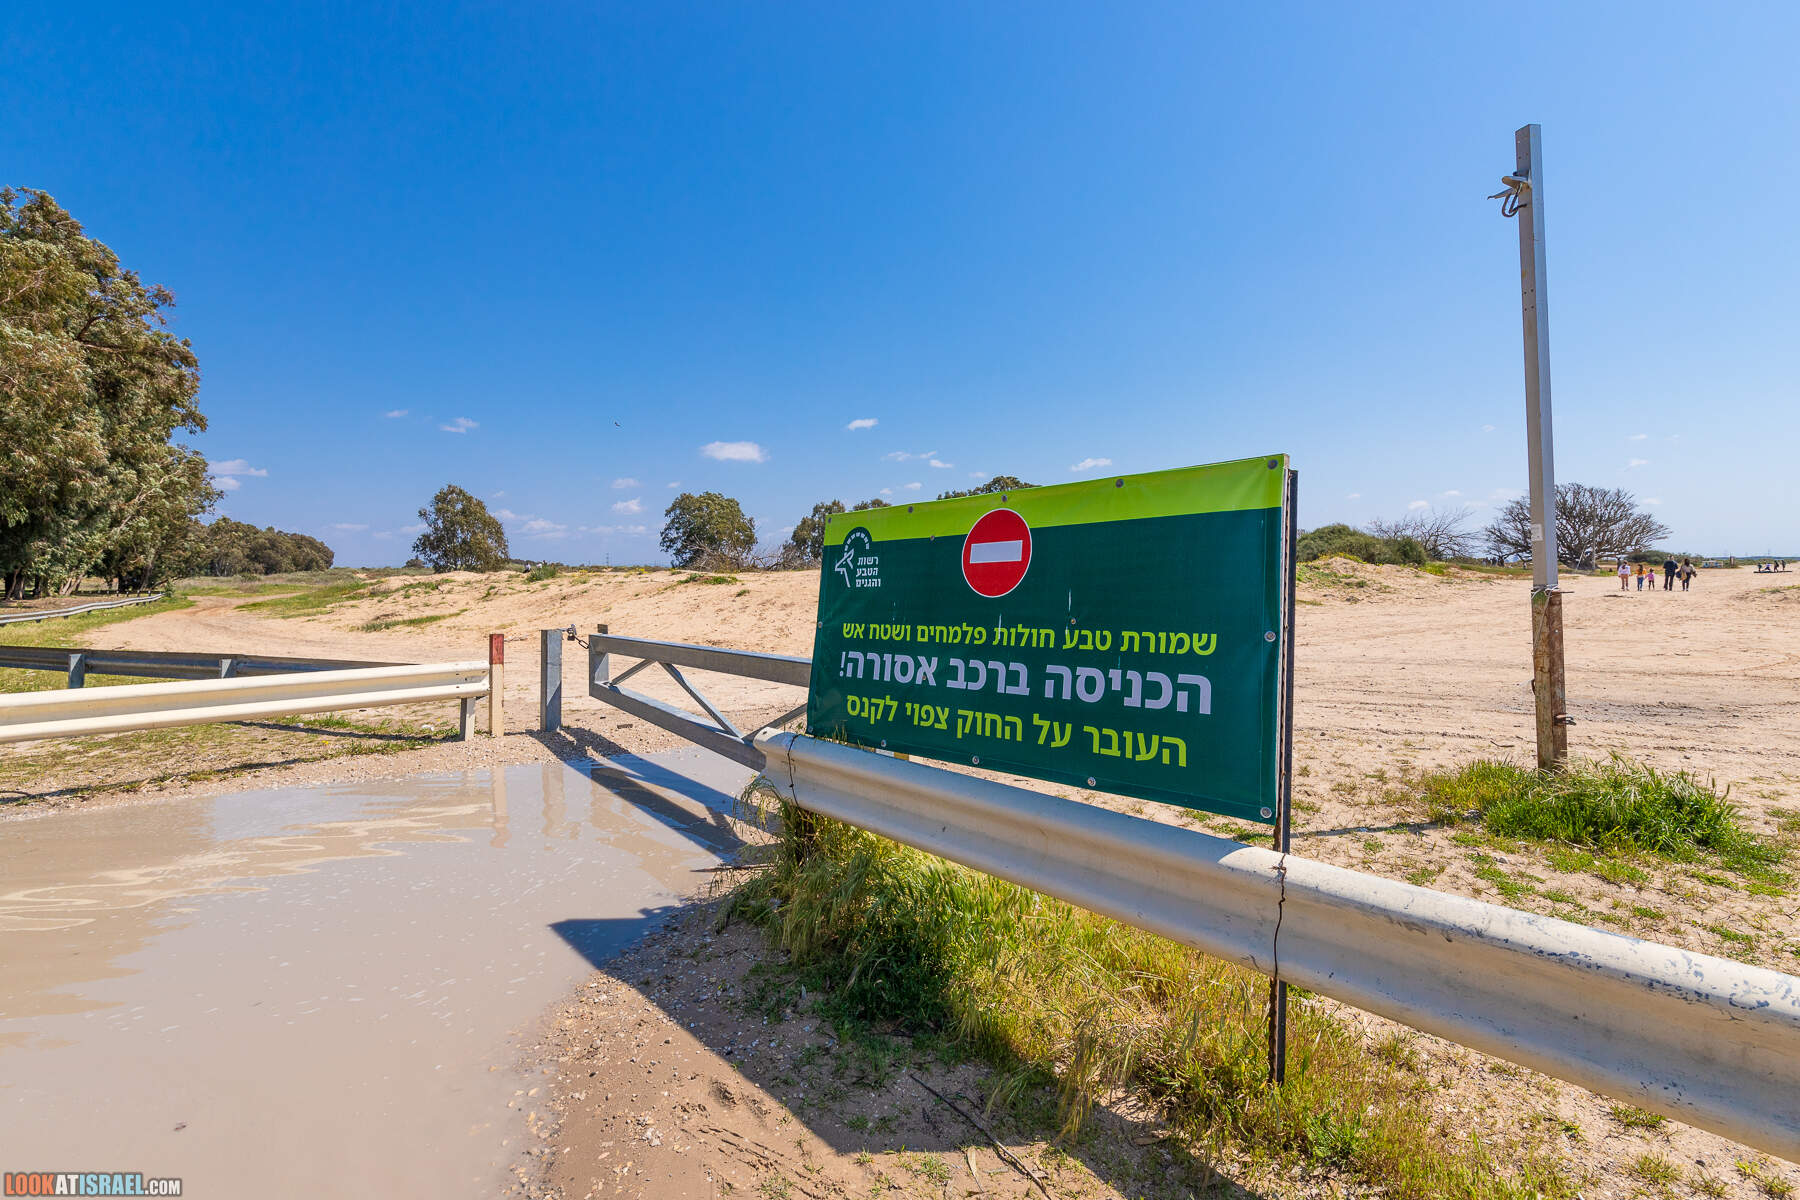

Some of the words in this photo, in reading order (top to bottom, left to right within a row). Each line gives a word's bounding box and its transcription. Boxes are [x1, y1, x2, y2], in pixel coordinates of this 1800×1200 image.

[855, 567, 879, 577] הטבע
[857, 556, 879, 565] רשות
[855, 578, 881, 588] והגנים
[842, 622, 866, 640] אש
[869, 623, 911, 642] ושטח
[917, 622, 987, 646] פלמחים
[994, 625, 1055, 648] חולות
[1062, 628, 1112, 650] טבע
[1120, 630, 1217, 656] שמורת
[839, 651, 938, 687] אסורה!
[946, 658, 1030, 696] ברכב
[1045, 664, 1212, 715] הכניסה
[847, 693, 898, 723] לקנס
[905, 702, 948, 731] צפוי
[957, 708, 1023, 742] החוק
[1033, 713, 1073, 748] על
[1083, 724, 1187, 768] העובר
